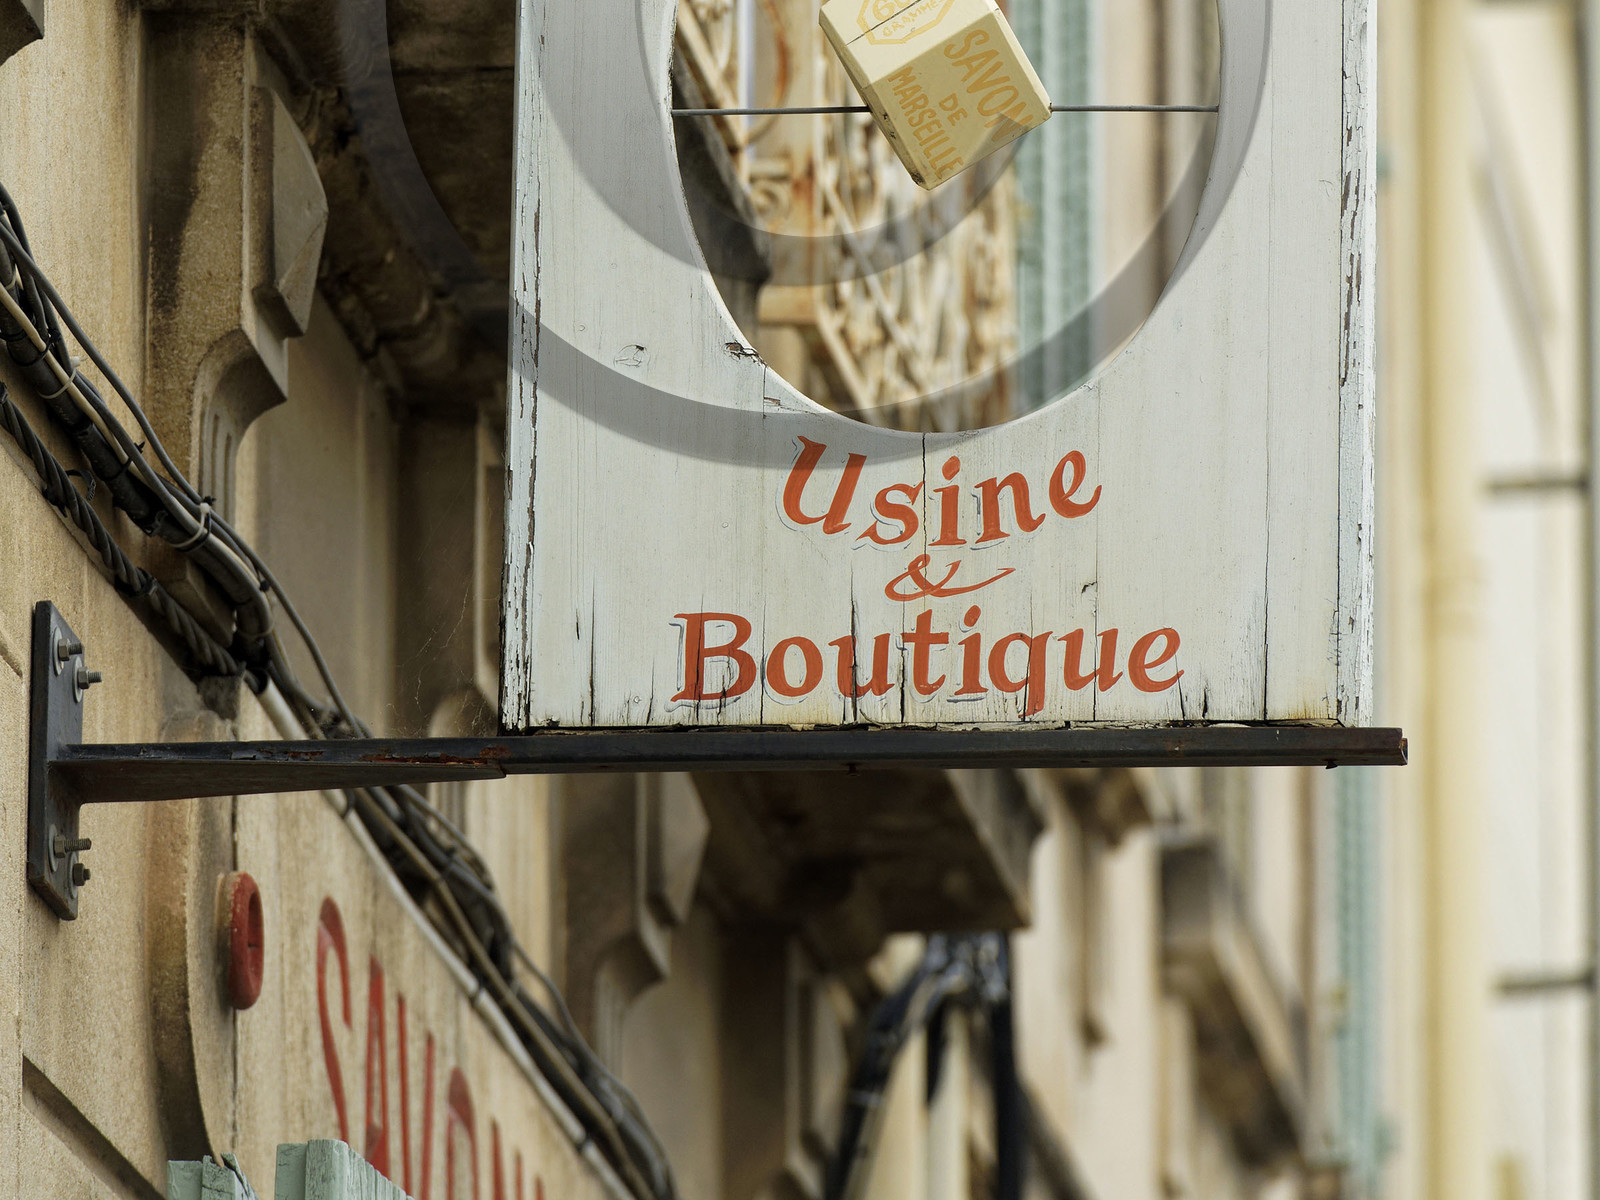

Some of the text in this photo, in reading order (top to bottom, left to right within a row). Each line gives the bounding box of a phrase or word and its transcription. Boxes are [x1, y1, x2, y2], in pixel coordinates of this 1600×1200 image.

[887, 65, 964, 180] MARSEILLE
[938, 92, 969, 127] DE
[943, 28, 1035, 143] SAVON
[780, 434, 1103, 548] Usine
[883, 552, 1016, 602] &
[670, 603, 1185, 720] Boutique
